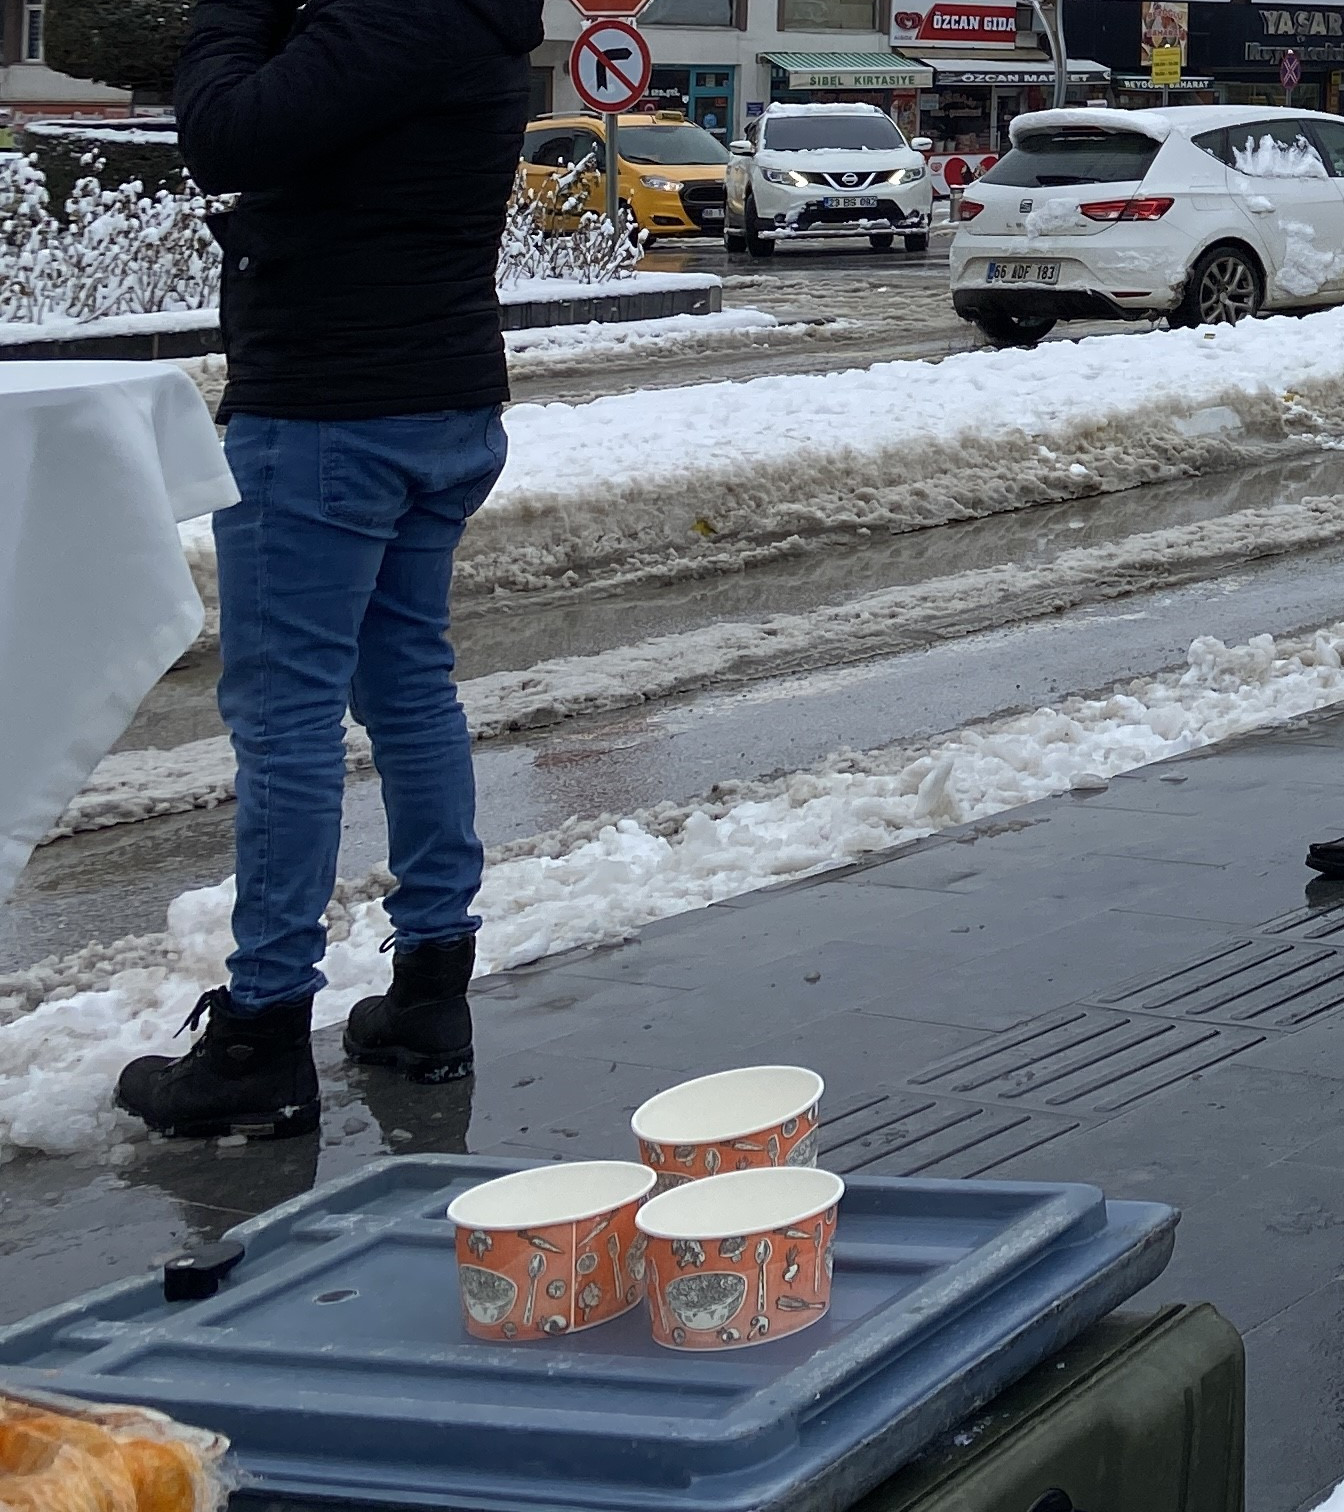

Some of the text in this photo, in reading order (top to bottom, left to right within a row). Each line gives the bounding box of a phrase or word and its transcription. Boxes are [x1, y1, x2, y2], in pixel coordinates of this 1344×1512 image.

[933, 11, 1017, 32] ÖZCAN GIDA
[961, 72, 1020, 82] ÖZCAN
[995, 264, 1055, 280] 66 ADF 183
